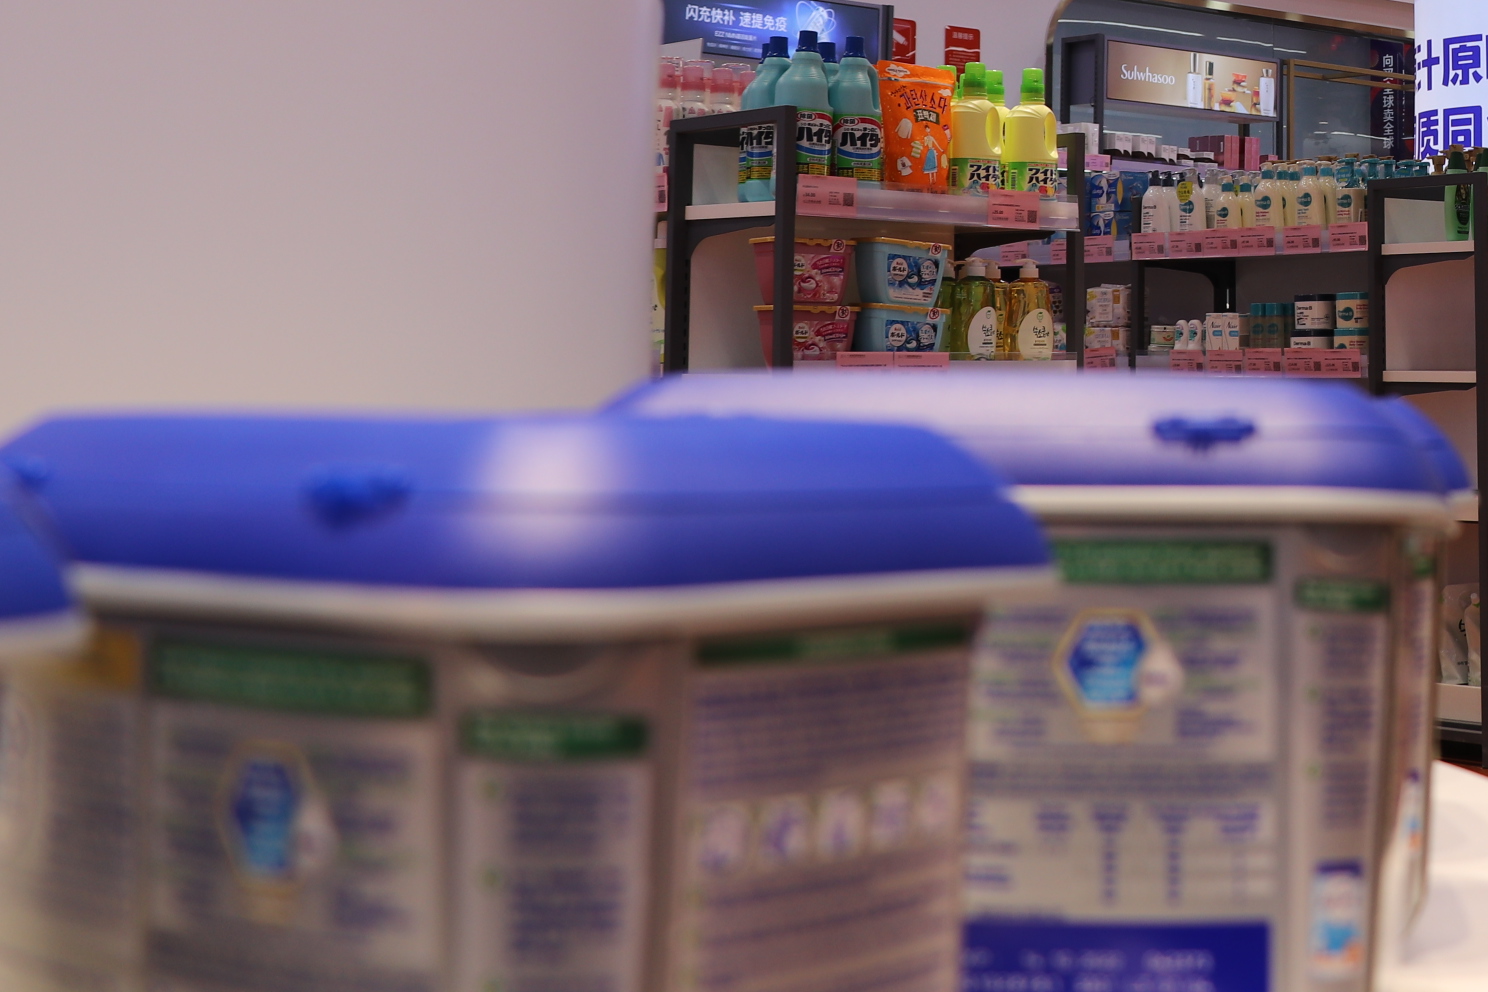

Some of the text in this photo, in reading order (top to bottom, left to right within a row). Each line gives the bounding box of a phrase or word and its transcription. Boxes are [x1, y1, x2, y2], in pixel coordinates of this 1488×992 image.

[685, 3, 788, 33] 闪充快补 速提免疫
[1120, 63, 1175, 86] Sulwhasoo
